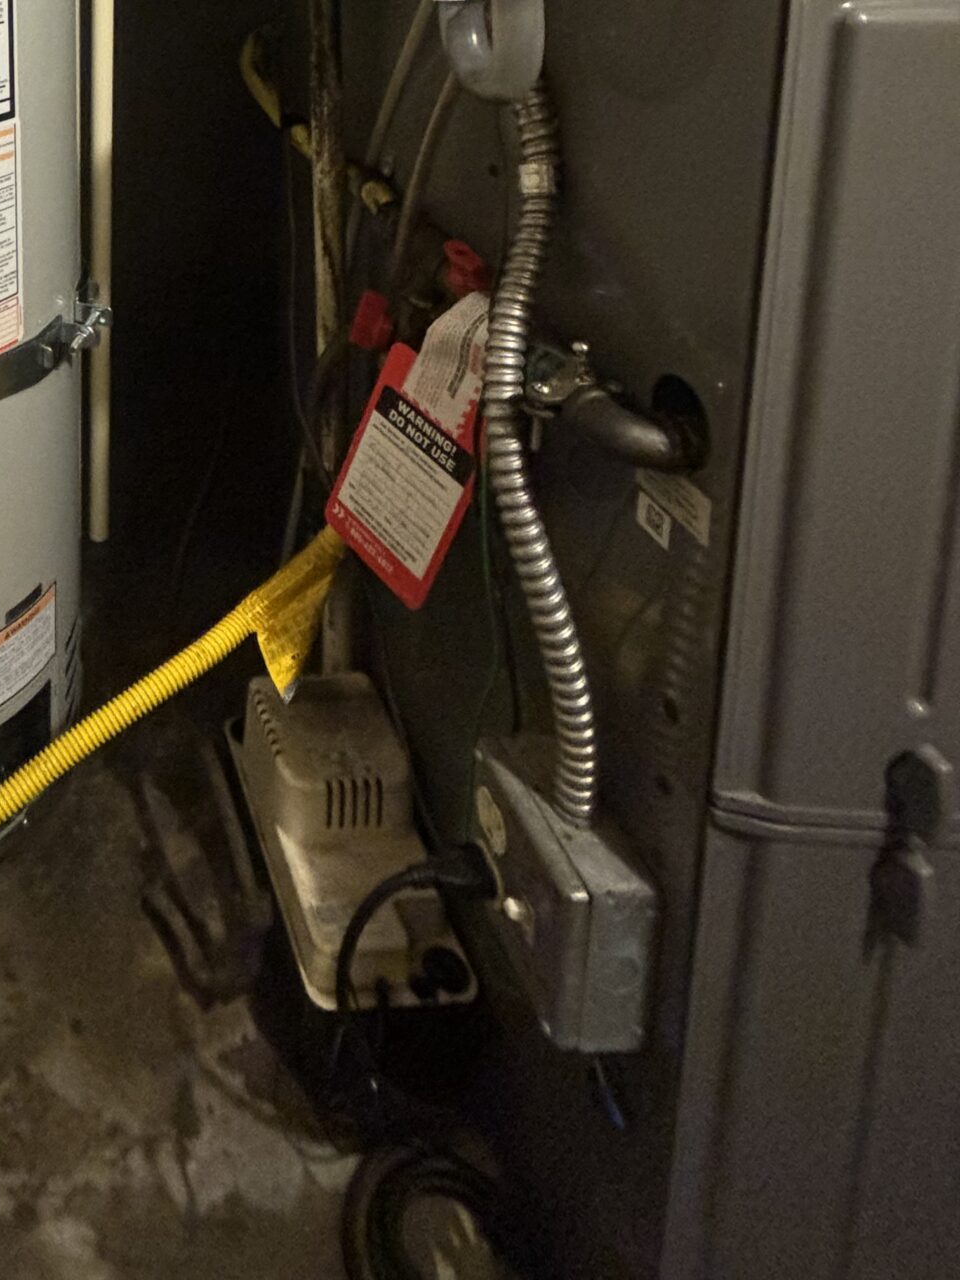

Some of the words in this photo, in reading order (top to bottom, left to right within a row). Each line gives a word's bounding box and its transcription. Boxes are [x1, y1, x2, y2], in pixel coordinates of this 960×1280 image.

[389, 409, 405, 428] DO
[406, 424, 430, 449] NOT
[431, 445, 456, 472] USE
[398, 400, 457, 456] WARNING!
